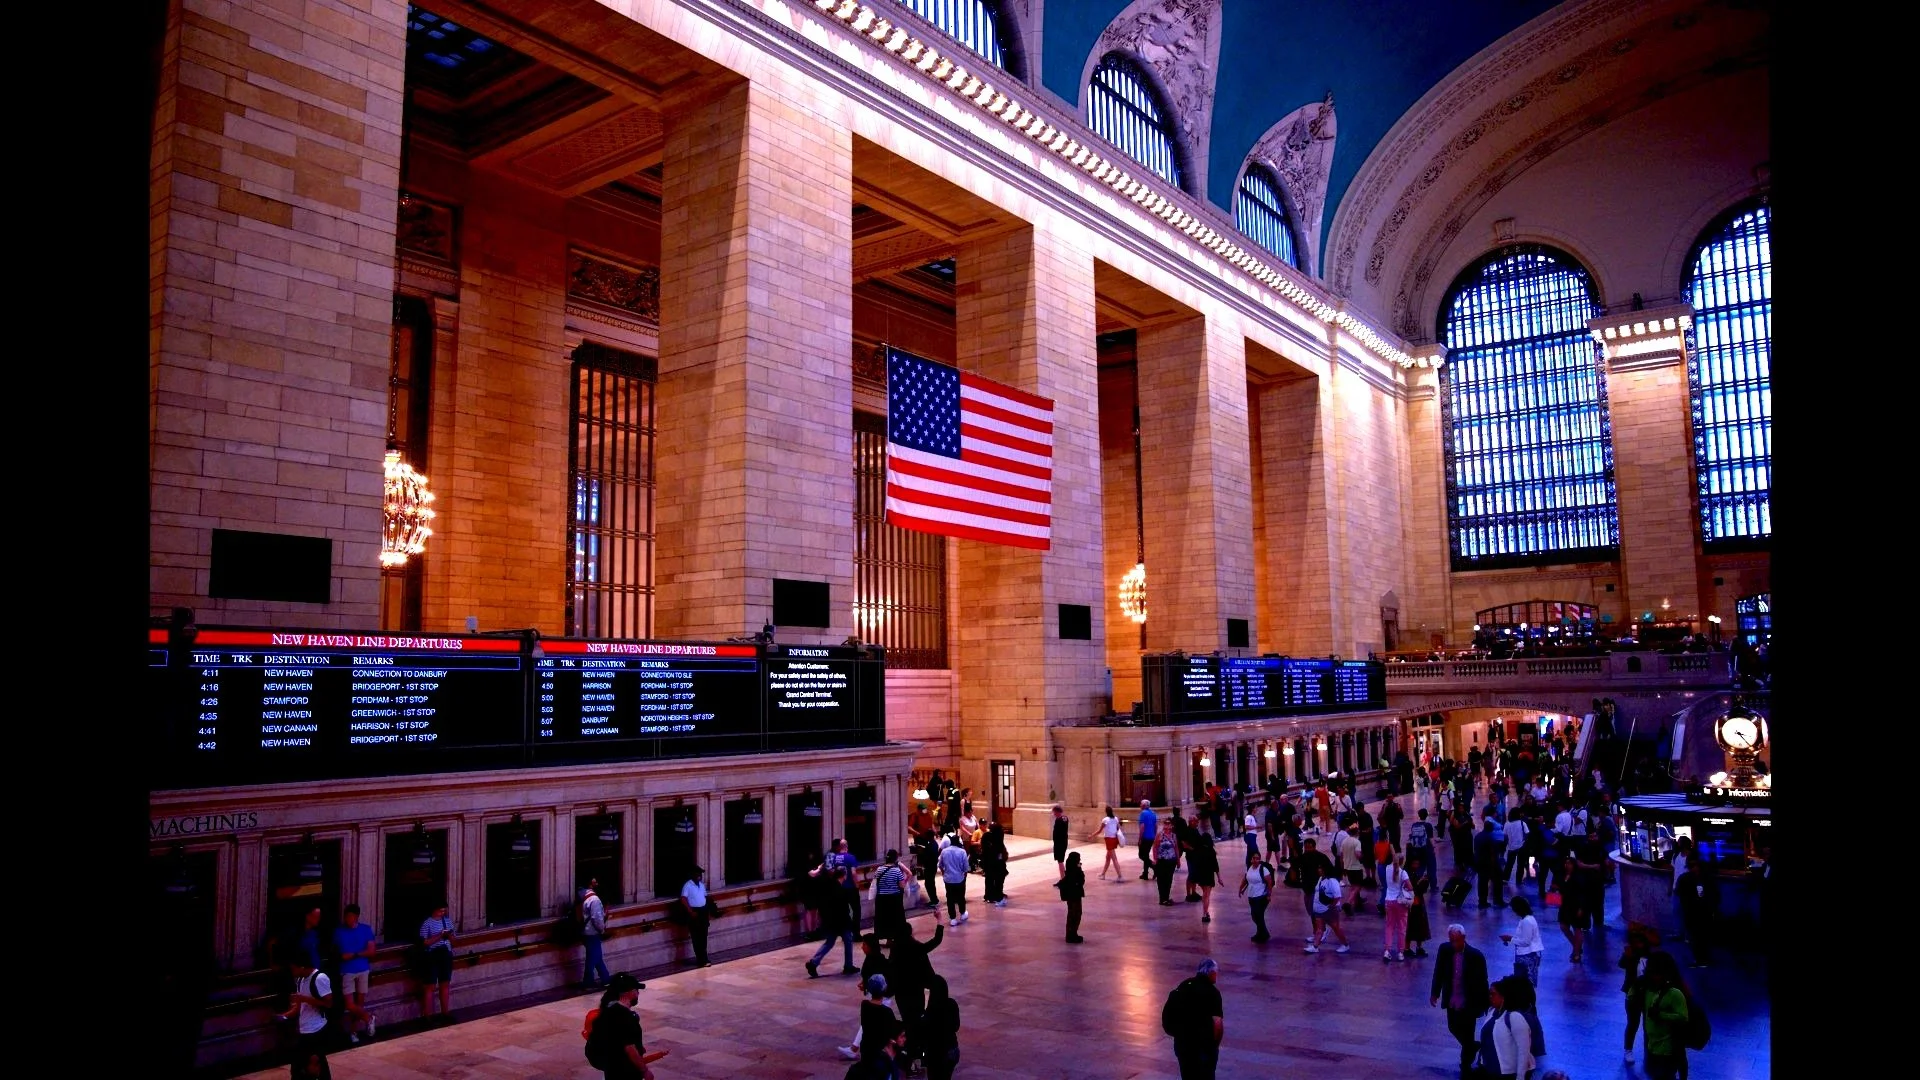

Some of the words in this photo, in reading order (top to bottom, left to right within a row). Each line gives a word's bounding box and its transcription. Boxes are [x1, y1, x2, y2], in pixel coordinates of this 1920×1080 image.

[272, 634, 304, 645] NEW
[308, 635, 353, 646] HAVEN
[356, 637, 386, 647] LINE
[389, 638, 462, 649] DEPARTURES
[587, 644, 609, 652] NEW
[610, 644, 641, 653] HAVEN
[643, 645, 663, 654] LINE
[665, 646, 716, 655] DEPARTURES
[264, 656, 329, 664] DESTINATION
[264, 697, 308, 705] STAMFORD
[1406, 704, 1431, 714] TICKET
[1434, 700, 1474, 709] MACHINES
[352, 709, 396, 717] GREENWICH
[351, 735, 399, 743] BRIDGEPORT
[150, 812, 257, 836] MACHINES
